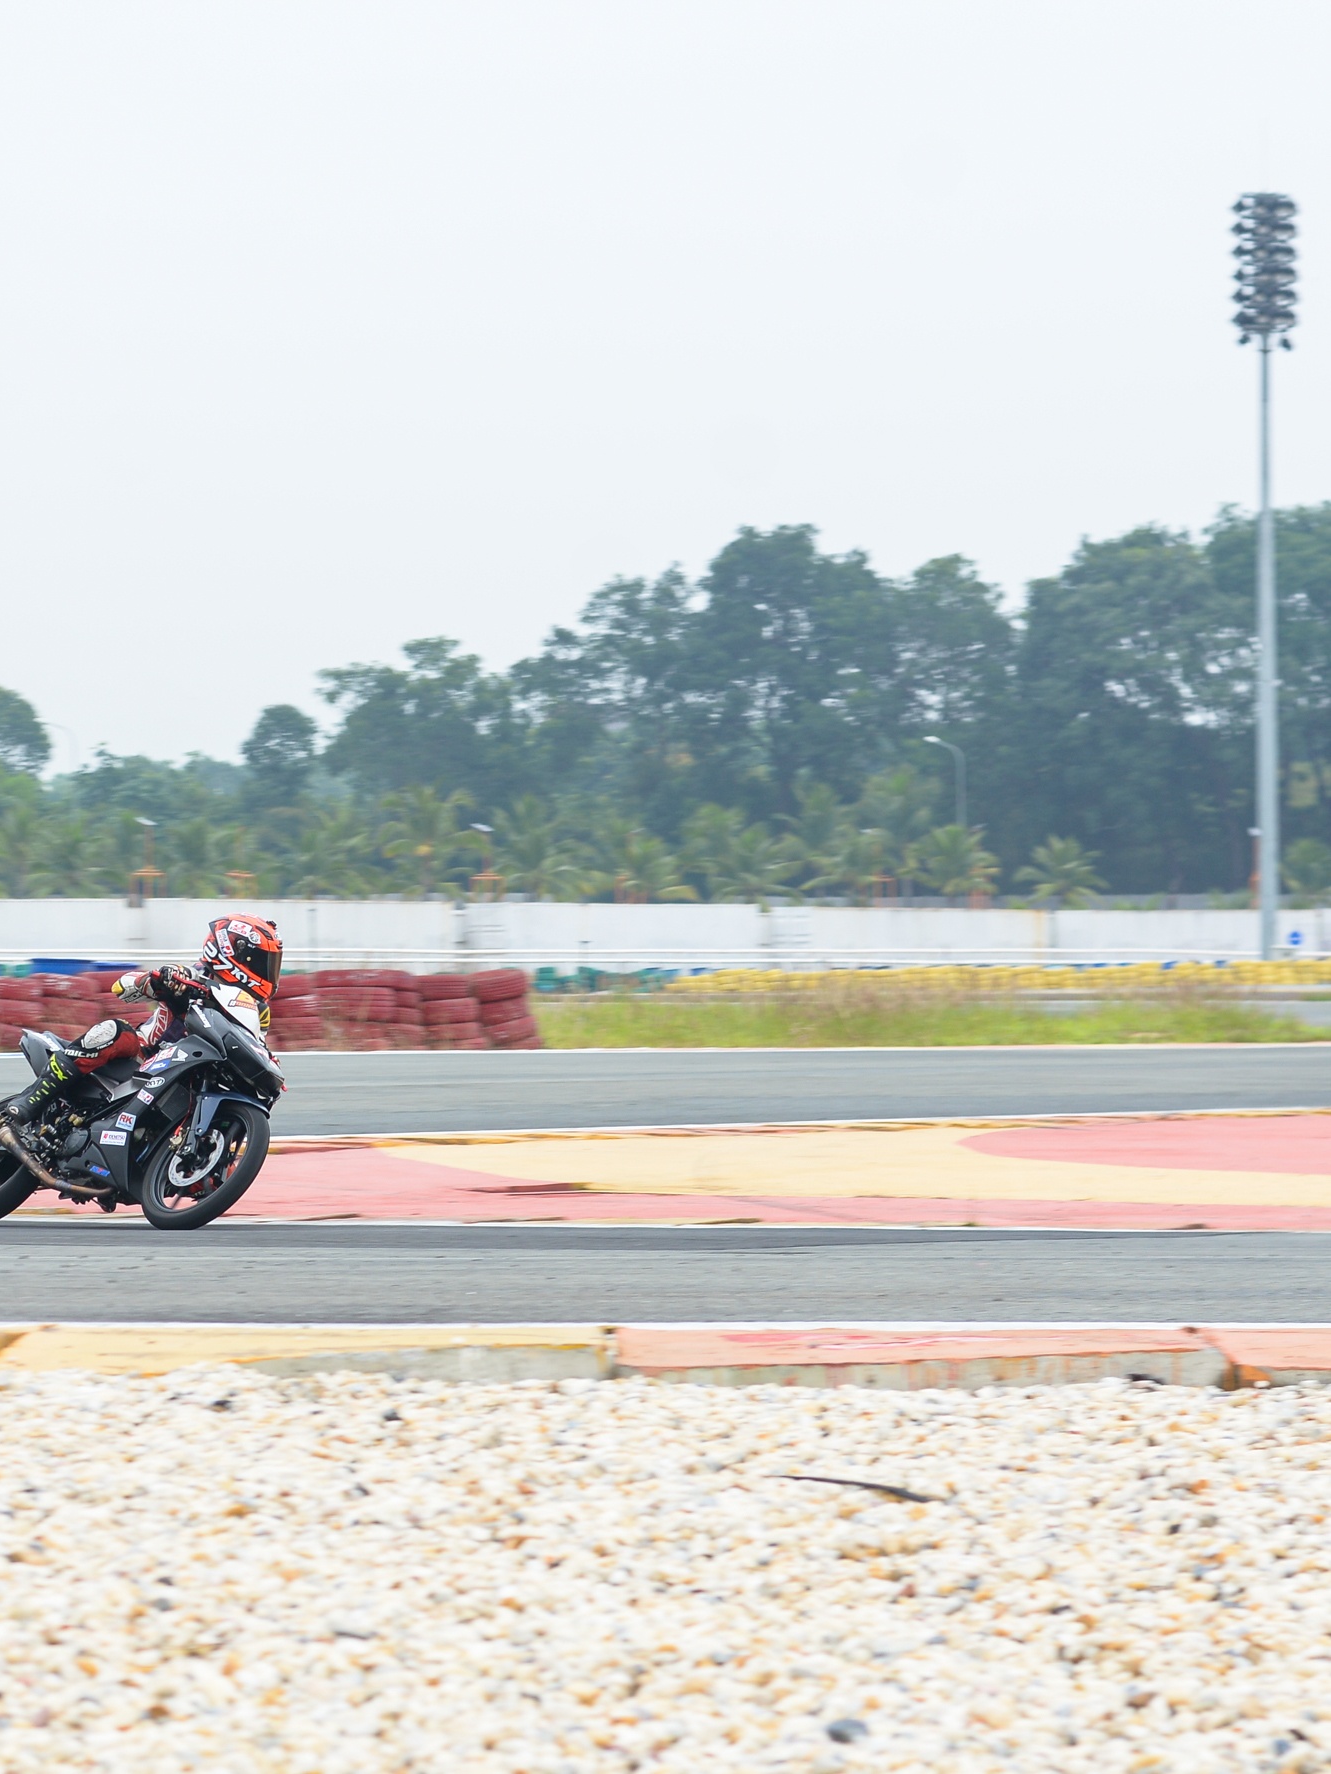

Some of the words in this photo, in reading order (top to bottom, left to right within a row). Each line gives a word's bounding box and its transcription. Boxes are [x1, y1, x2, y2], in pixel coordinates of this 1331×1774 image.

[203, 941, 233, 970] 27
[63, 1048, 99, 1059] TAICHI
[120, 1114, 133, 1124] RK
